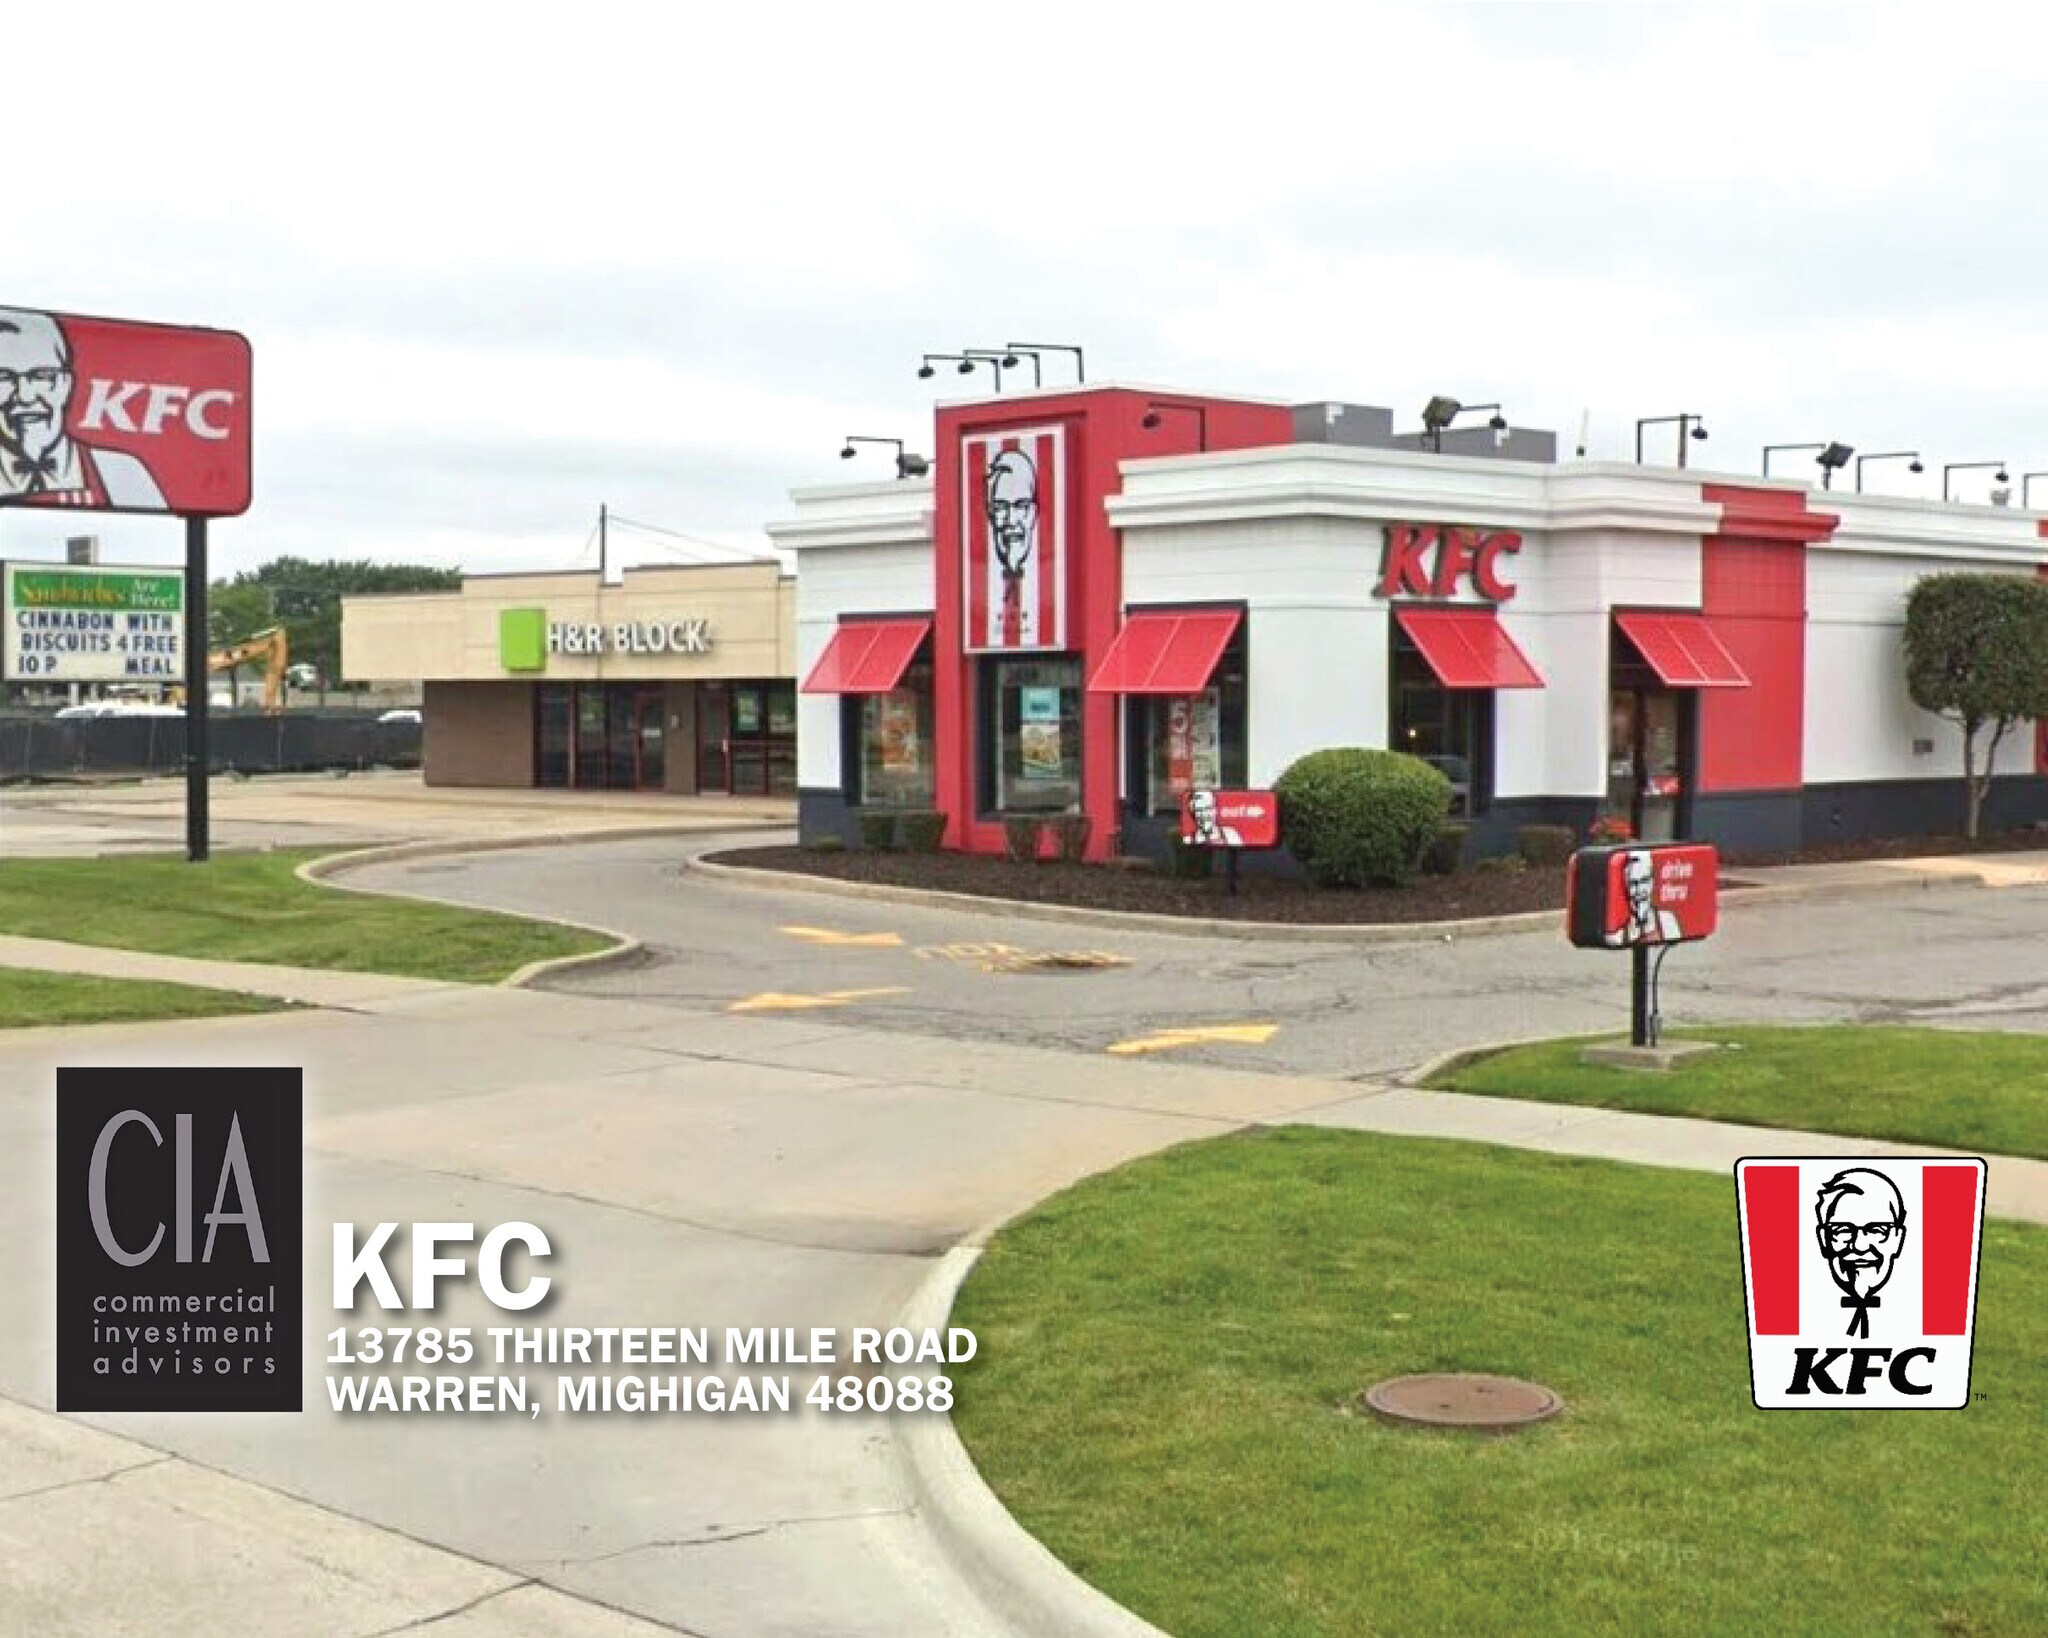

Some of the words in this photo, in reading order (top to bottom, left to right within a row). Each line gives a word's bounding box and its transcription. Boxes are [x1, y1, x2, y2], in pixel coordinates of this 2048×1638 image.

[78, 378, 234, 440] KFC
[1371, 525, 1523, 601] KFC
[18, 611, 114, 630] CINNABON
[127, 613, 173, 631] WITH
[21, 633, 111, 651] BISCUITS
[133, 635, 178, 653] FREE
[548, 622, 604, 653] H&R
[614, 620, 707, 653] BLOCK
[126, 658, 174, 674] MEAL
